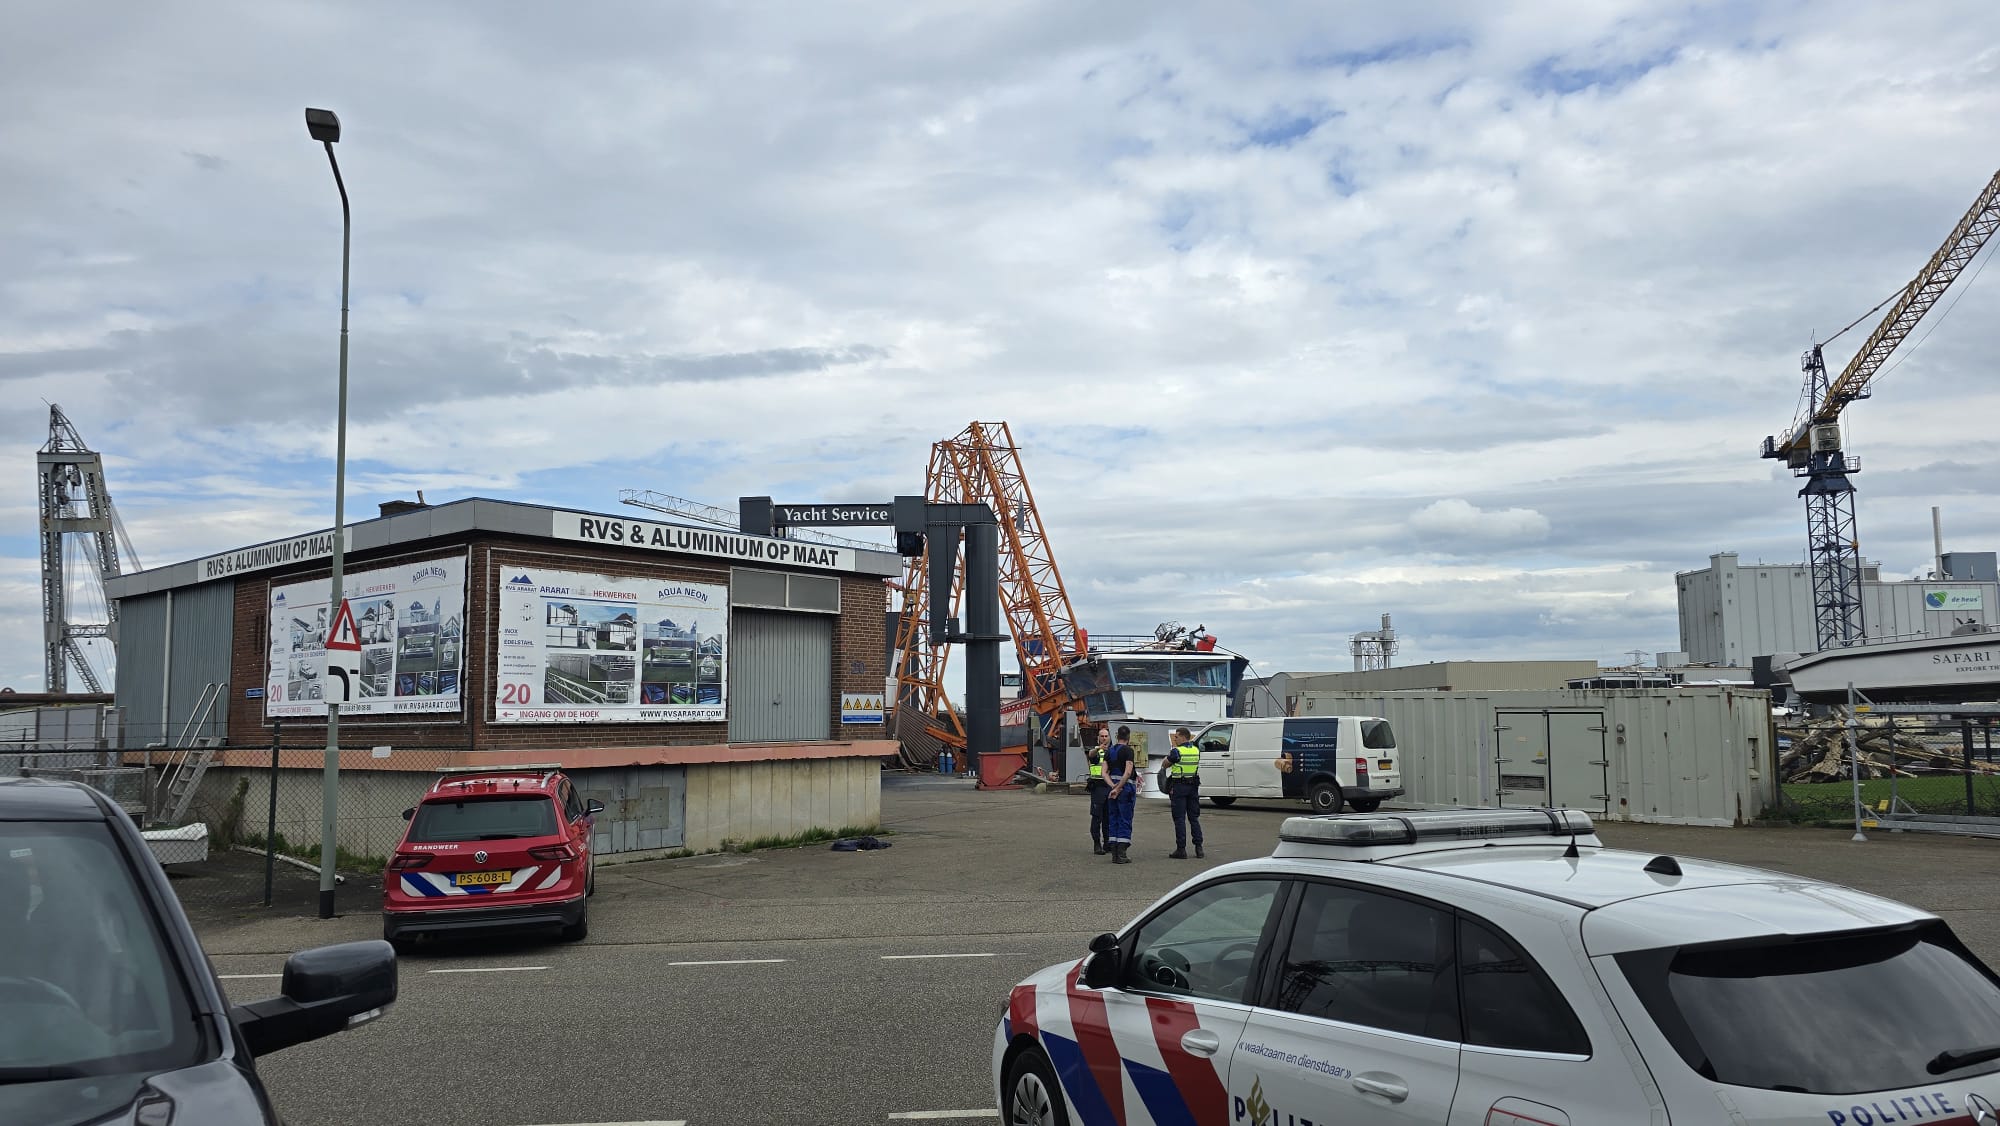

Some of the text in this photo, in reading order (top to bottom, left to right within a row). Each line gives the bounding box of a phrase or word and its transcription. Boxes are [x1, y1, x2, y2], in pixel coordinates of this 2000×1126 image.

[784, 507, 888, 521] Yacht Service
[580, 518, 839, 567] RVS & ALUMINIUM OP MAAT
[207, 534, 335, 577] RVS & ALUMINIUM OP MAA
[412, 567, 447, 583] AQUA NEON
[540, 586, 570, 595] ARARAT
[593, 590, 637, 599] HEKWERKEN
[658, 587, 708, 602] AQUA NEON
[1932, 651, 1991, 665] SAFARI
[1956, 665, 1987, 673] EXPLORE
[270, 685, 282, 702] 20
[502, 683, 531, 705] 20
[640, 710, 722, 718] WWW.RVSARARAT.COM
[460, 872, 508, 883] PS-608-L
[1244, 1043, 1286, 1061] waakzaam
[1286, 1053, 1297, 1065] en
[1297, 1054, 1345, 1078] dienstbaar
[1827, 1092, 1956, 1126] POLITIE
